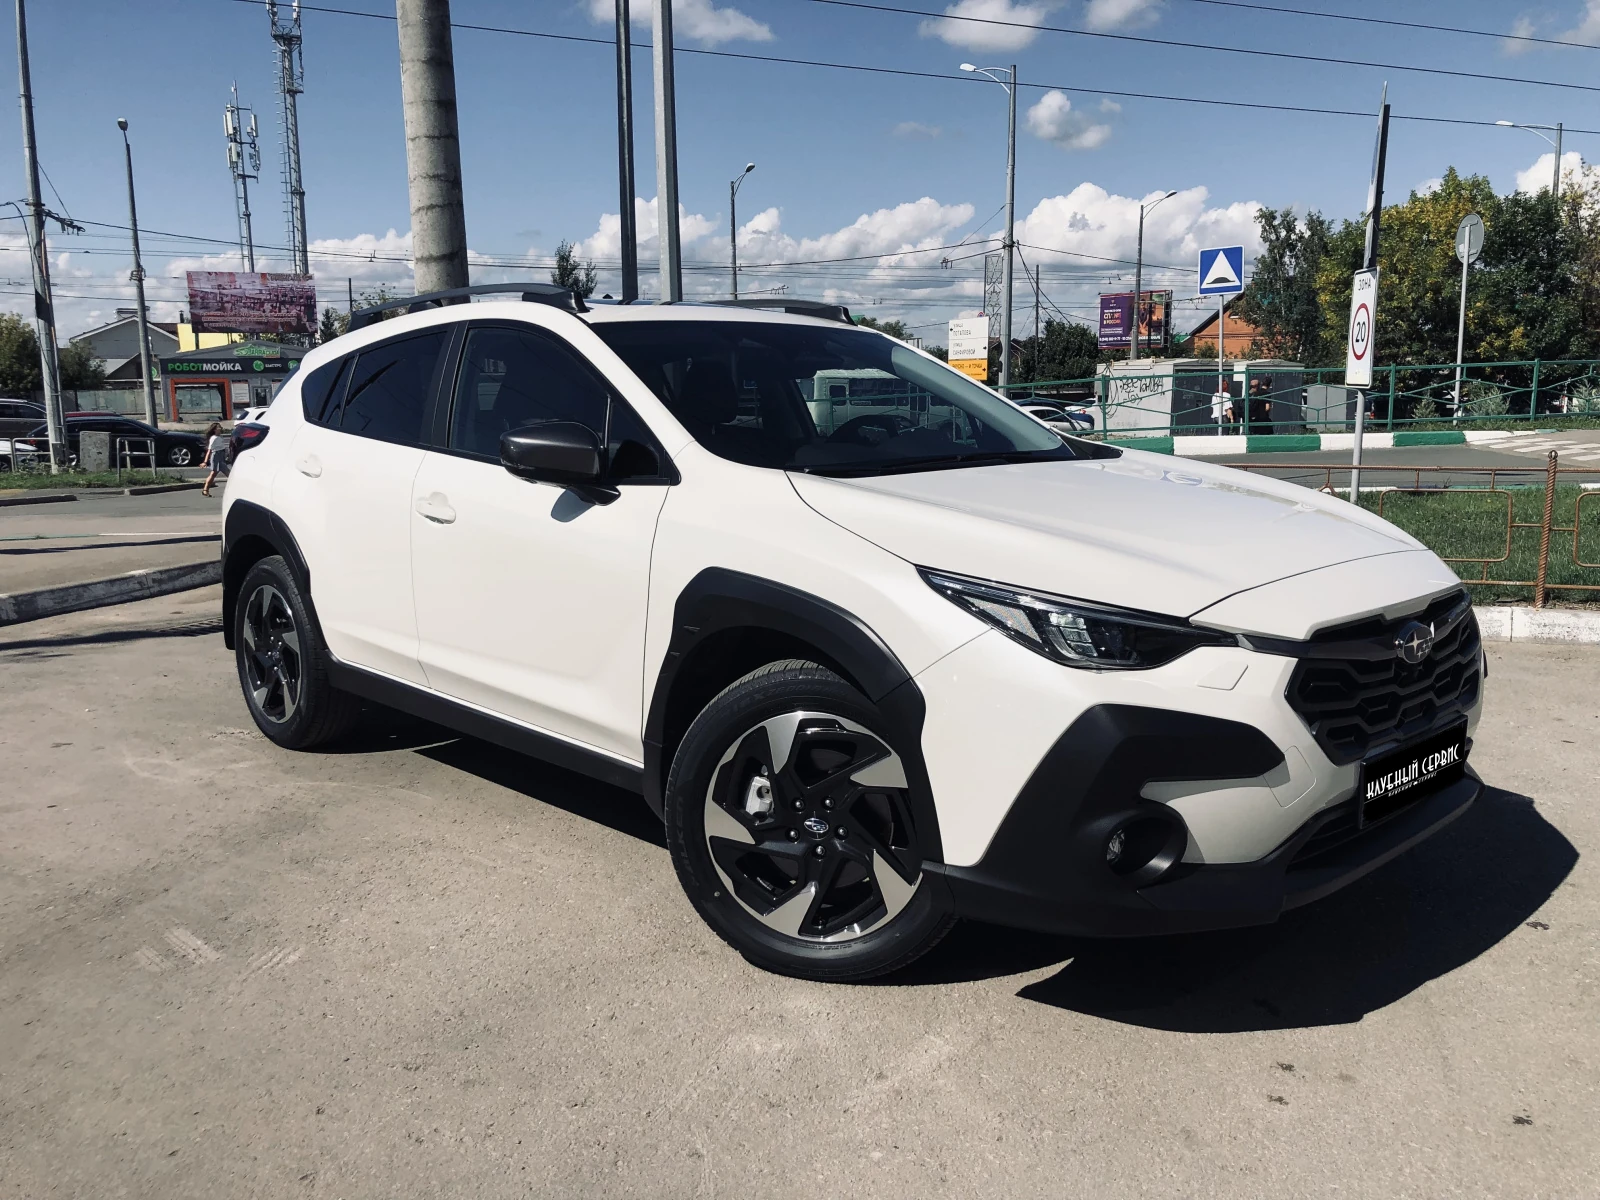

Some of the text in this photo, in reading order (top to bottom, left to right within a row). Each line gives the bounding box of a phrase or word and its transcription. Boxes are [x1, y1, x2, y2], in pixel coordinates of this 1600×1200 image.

[1358, 278, 1372, 291] ЗОНА
[1355, 321, 1367, 343] 20
[168, 361, 242, 371] РОБОТМОЙКА
[1366, 759, 1418, 799] КЛУБНЫЙ
[1422, 743, 1459, 773] СЕРВИС
